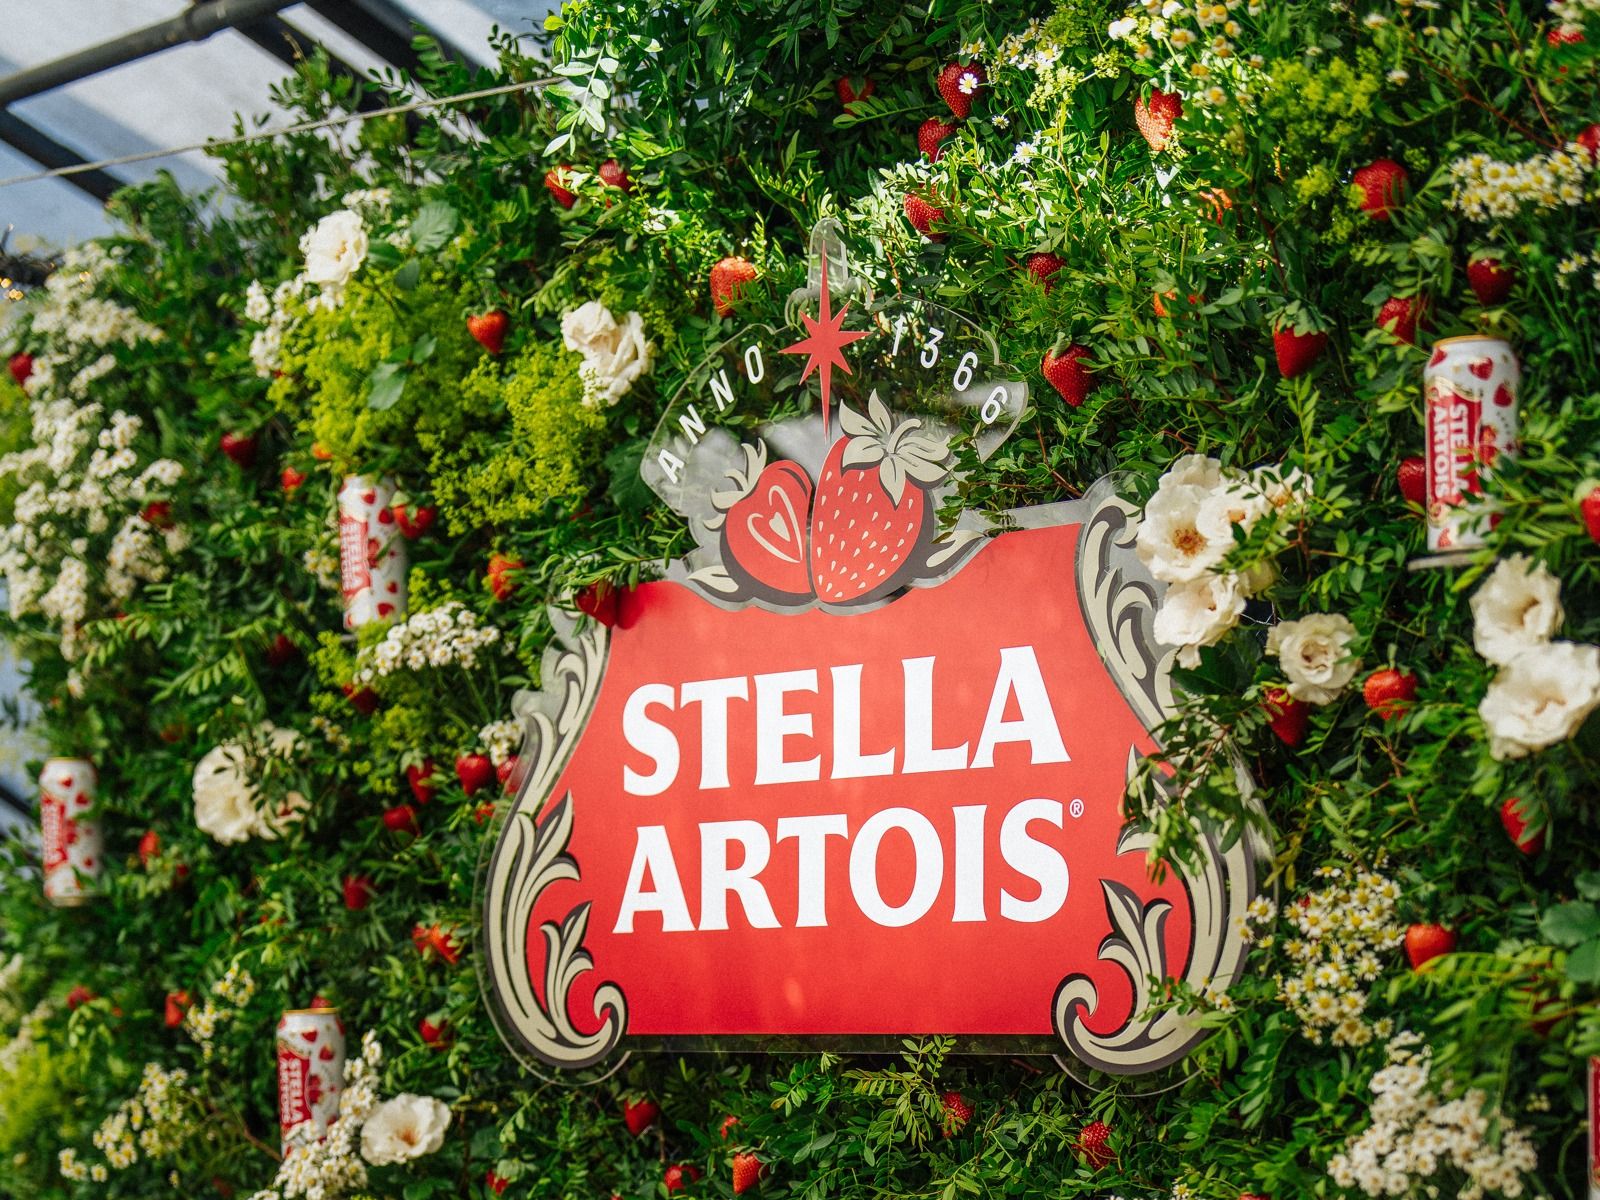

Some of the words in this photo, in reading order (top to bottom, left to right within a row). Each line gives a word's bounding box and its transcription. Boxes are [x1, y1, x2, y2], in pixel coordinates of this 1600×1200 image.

[656, 345, 765, 484] ANNO
[892, 314, 1008, 425] 1366
[1433, 405, 1449, 499] ARTOIS
[622, 645, 1072, 796] STELLA
[288, 1058, 303, 1122] STELLA
